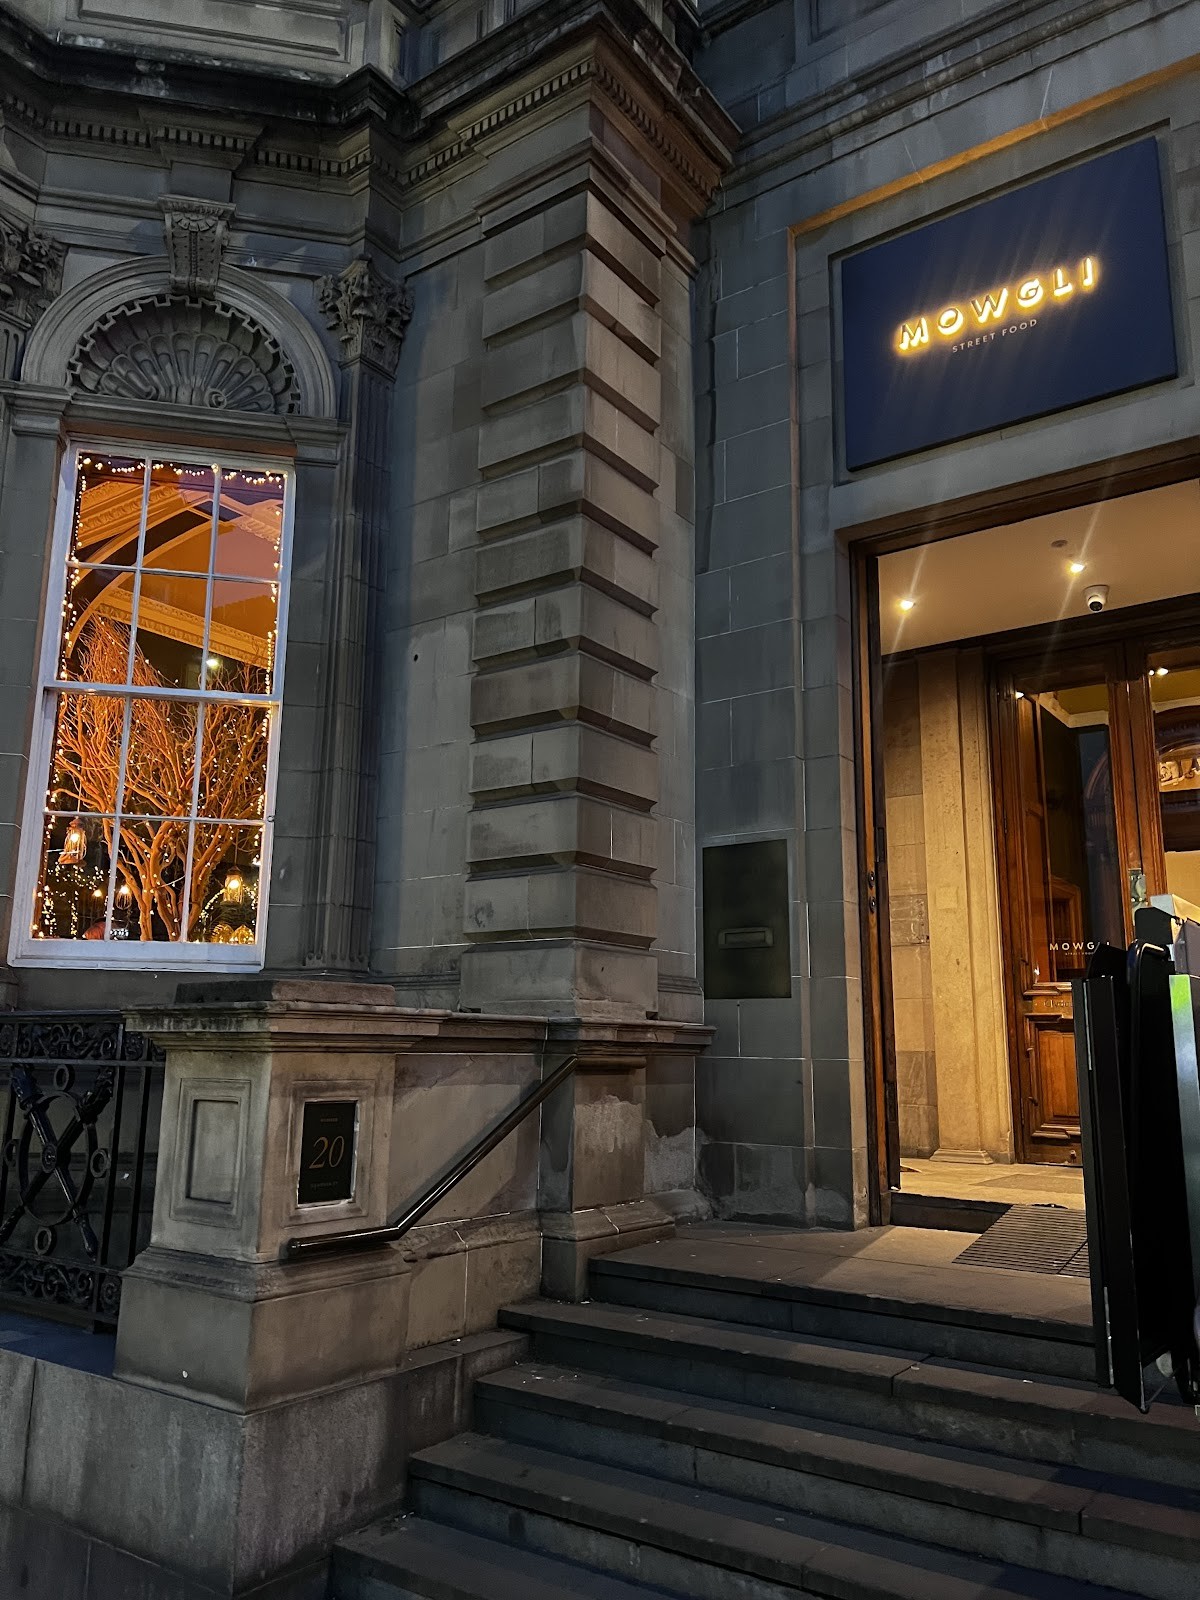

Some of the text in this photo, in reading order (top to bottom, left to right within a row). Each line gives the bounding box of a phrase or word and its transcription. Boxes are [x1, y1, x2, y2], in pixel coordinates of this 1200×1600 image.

[898, 256, 1095, 351] MOWGLI
[952, 319, 1037, 353] STREET FOOD
[1049, 941, 1110, 951] MOWG
[309, 1135, 345, 1169] 20
